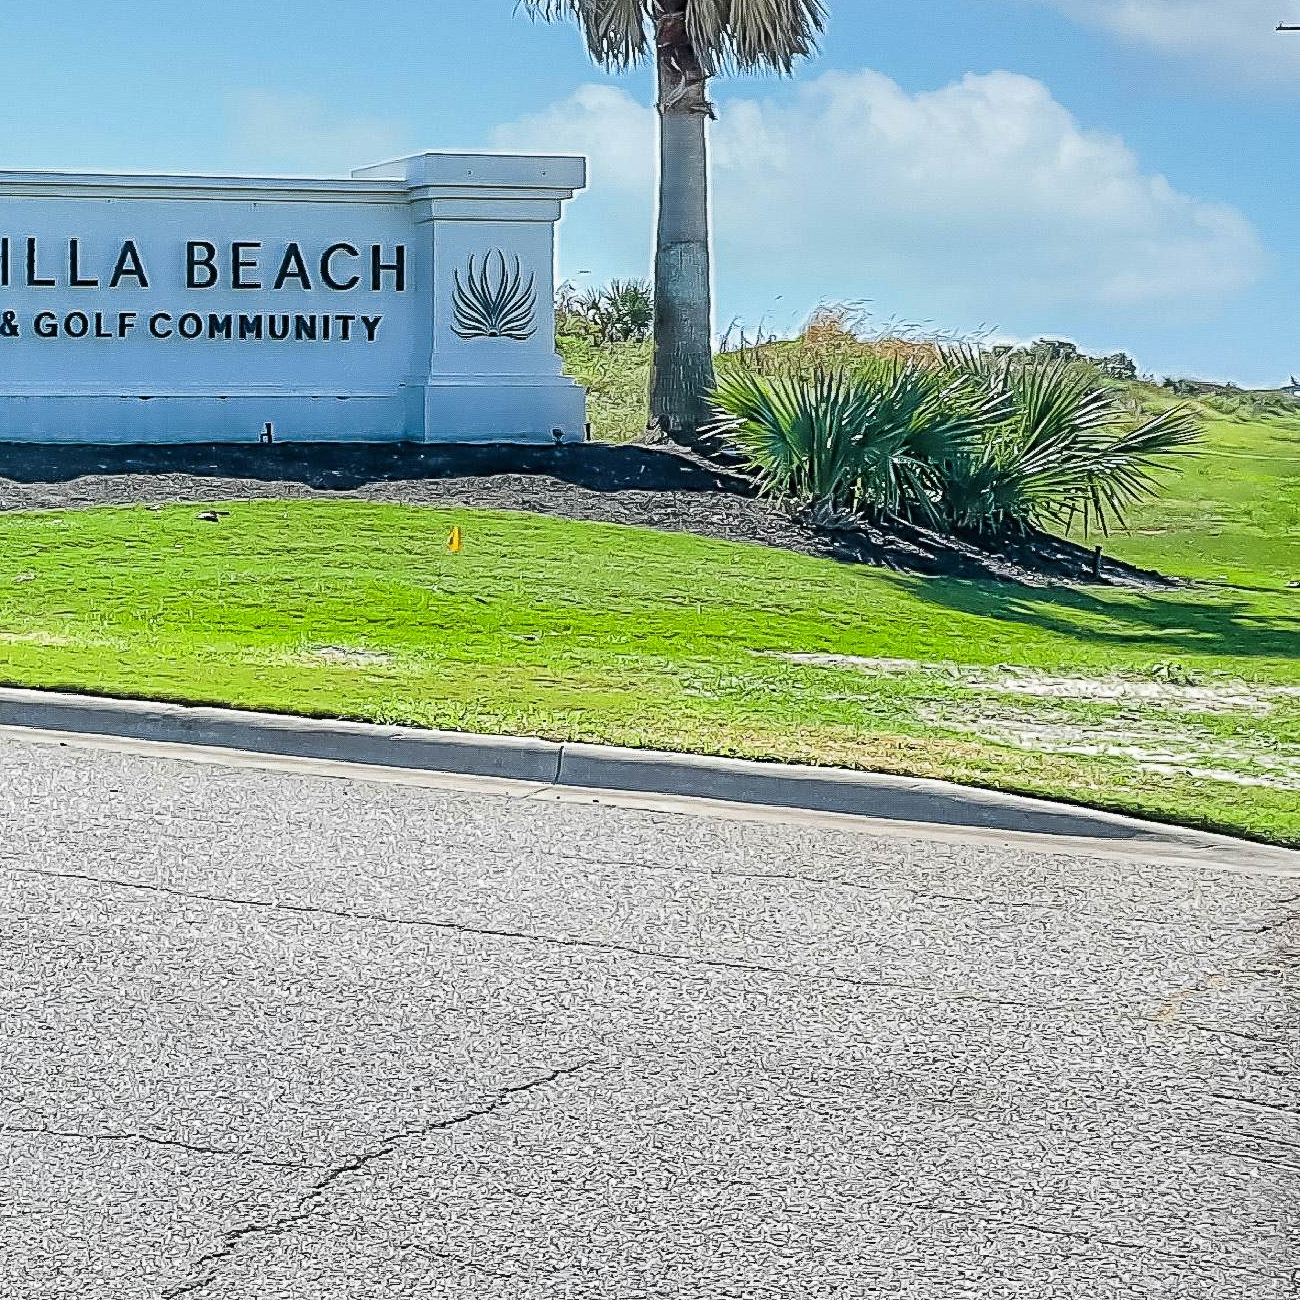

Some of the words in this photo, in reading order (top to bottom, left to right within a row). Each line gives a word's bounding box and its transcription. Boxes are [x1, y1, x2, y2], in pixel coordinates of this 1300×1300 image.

[185, 241, 405, 292] BEACH
[33, 311, 137, 339] GOLF
[148, 311, 383, 342] COMMUNITY
